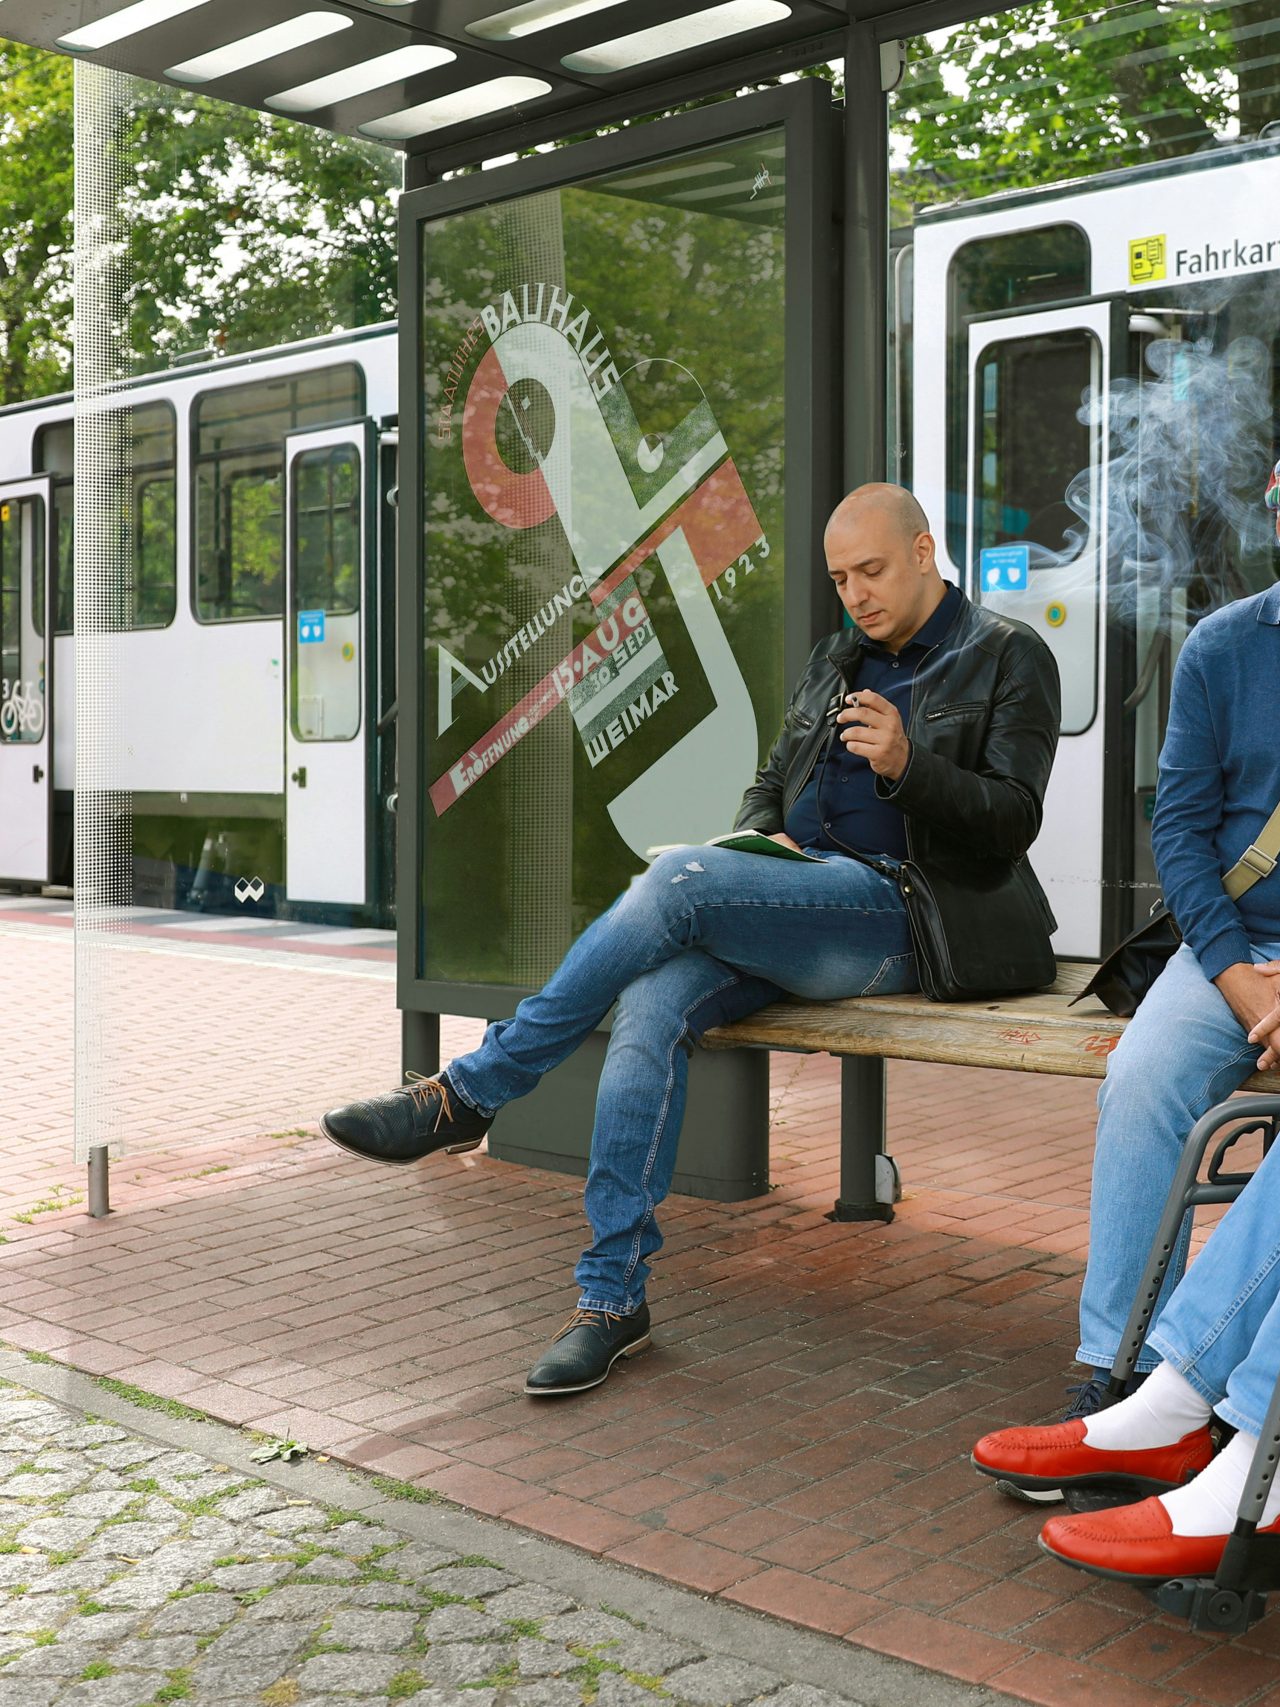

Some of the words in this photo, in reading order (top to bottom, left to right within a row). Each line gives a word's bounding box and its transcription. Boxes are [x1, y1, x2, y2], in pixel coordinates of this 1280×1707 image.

[480, 282, 620, 402] BAUHAUS
[712, 533, 770, 600] 1923
[436, 574, 587, 741] AUSSTELLUNG
[582, 597, 646, 676] AUG
[449, 716, 529, 798] ERÖFFNUNG
[584, 670, 680, 769] WEIMAR
